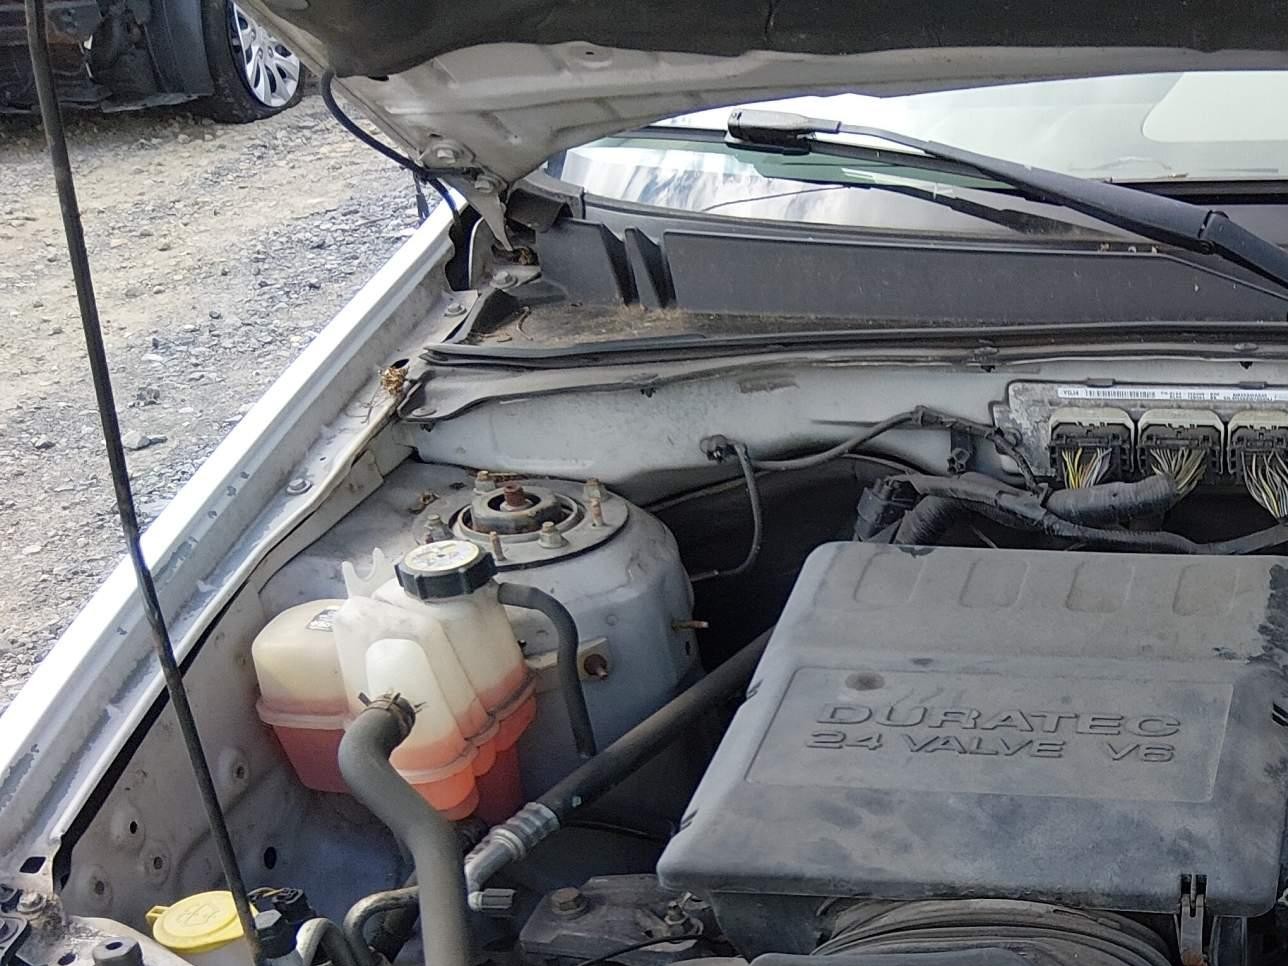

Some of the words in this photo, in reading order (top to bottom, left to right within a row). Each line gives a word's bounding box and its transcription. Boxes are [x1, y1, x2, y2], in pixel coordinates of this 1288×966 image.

[816, 703, 1182, 738] DURATEC
[806, 731, 884, 752] 24
[904, 734, 1066, 759] VALVE
[1104, 742, 1176, 763] V6
